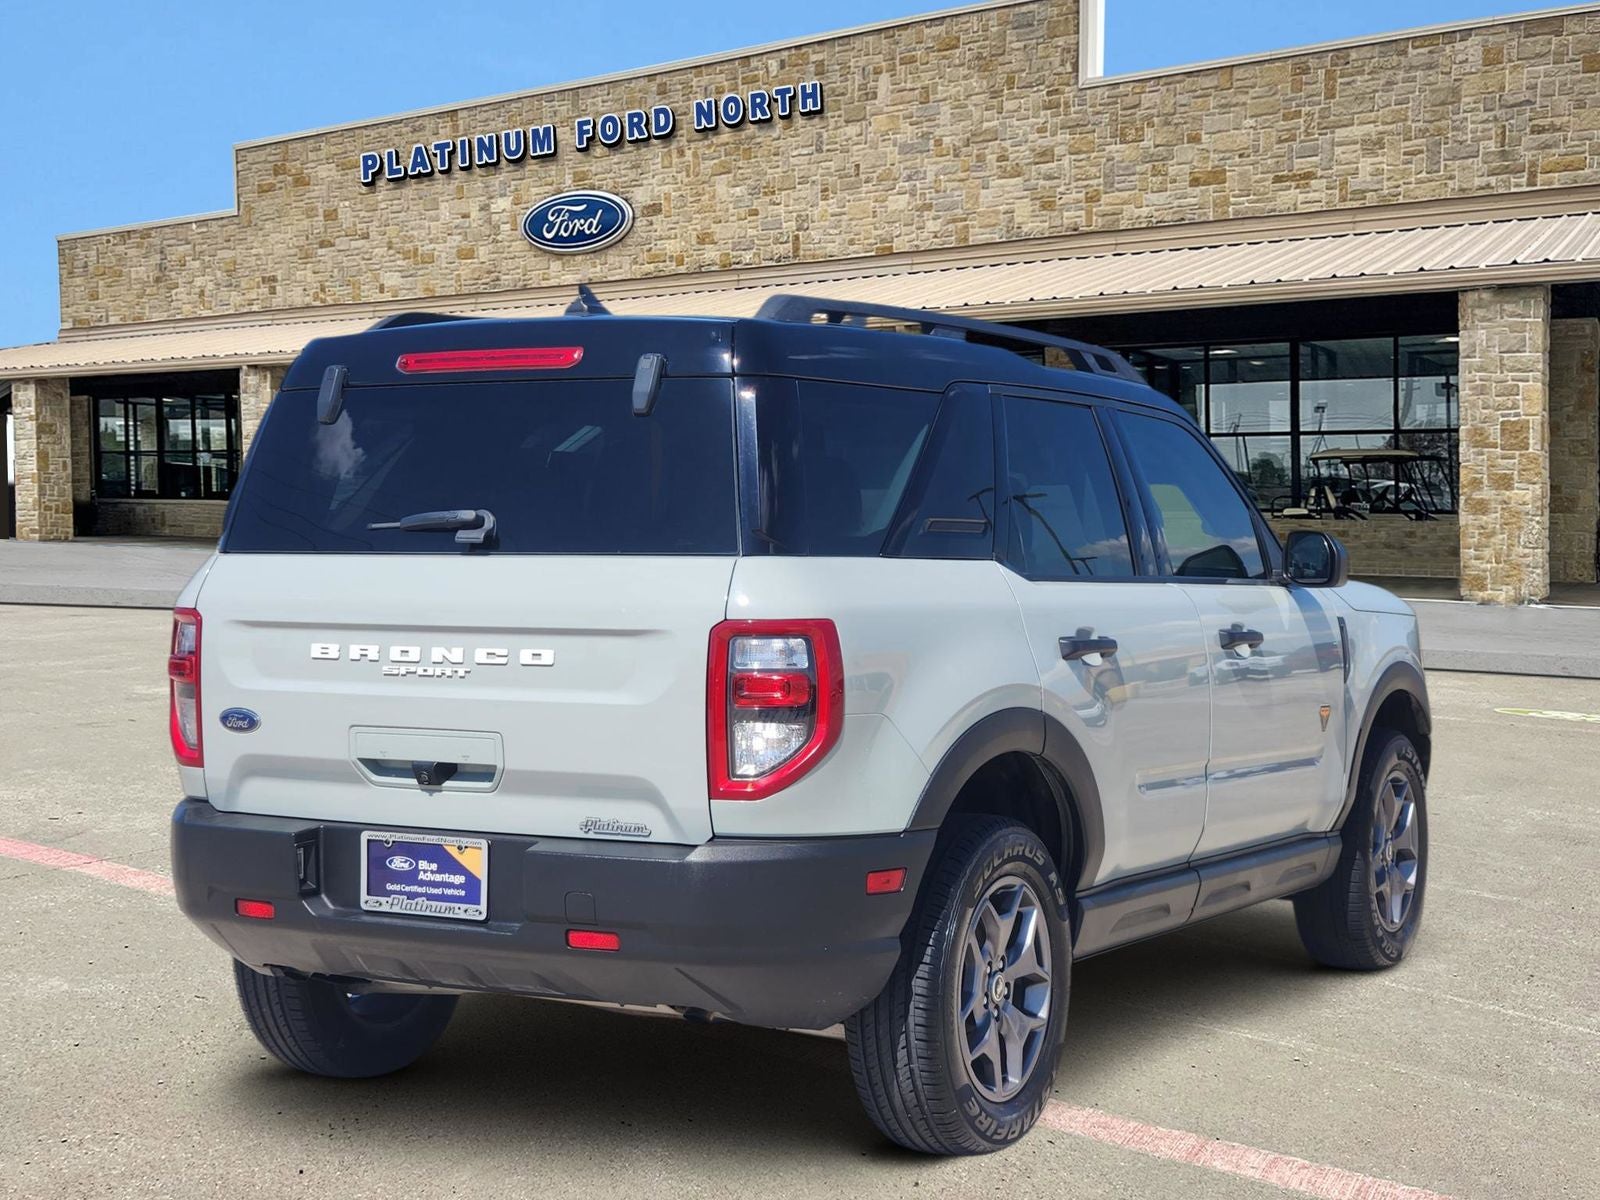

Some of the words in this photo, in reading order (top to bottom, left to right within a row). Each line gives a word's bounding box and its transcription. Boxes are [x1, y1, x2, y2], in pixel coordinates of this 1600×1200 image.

[361, 125, 557, 185] PLATINUM
[575, 105, 674, 152] FORD
[693, 81, 821, 131] NORTH
[542, 203, 603, 239] Ford
[310, 643, 555, 666] BRONCO
[382, 666, 471, 678] SPORT
[226, 713, 250, 728] Ford
[580, 817, 651, 835] Platinum
[391, 859, 410, 868] Ford
[418, 860, 437, 870] Blue
[418, 871, 466, 884] Advantage
[386, 883, 400, 891] Gold
[401, 885, 426, 893] Certified
[443, 888, 465, 896] Vehicle
[389, 896, 459, 915] Platinum
